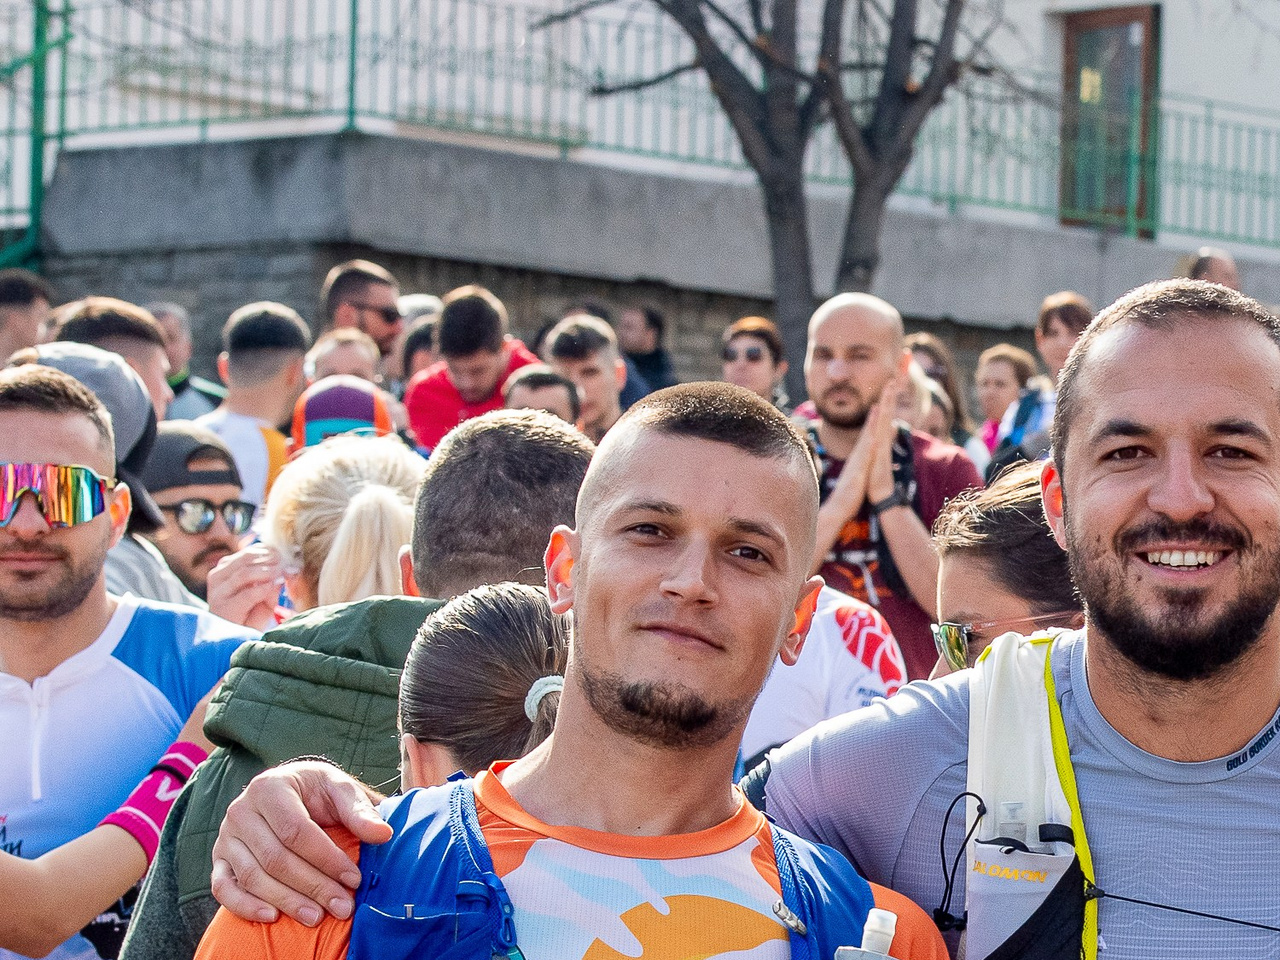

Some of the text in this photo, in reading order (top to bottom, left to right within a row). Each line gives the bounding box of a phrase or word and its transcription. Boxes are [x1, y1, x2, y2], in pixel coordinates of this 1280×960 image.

[1226, 751, 1248, 771] GOLD
[1249, 726, 1277, 759] BORDER
[973, 860, 1047, 883] ALOMON
